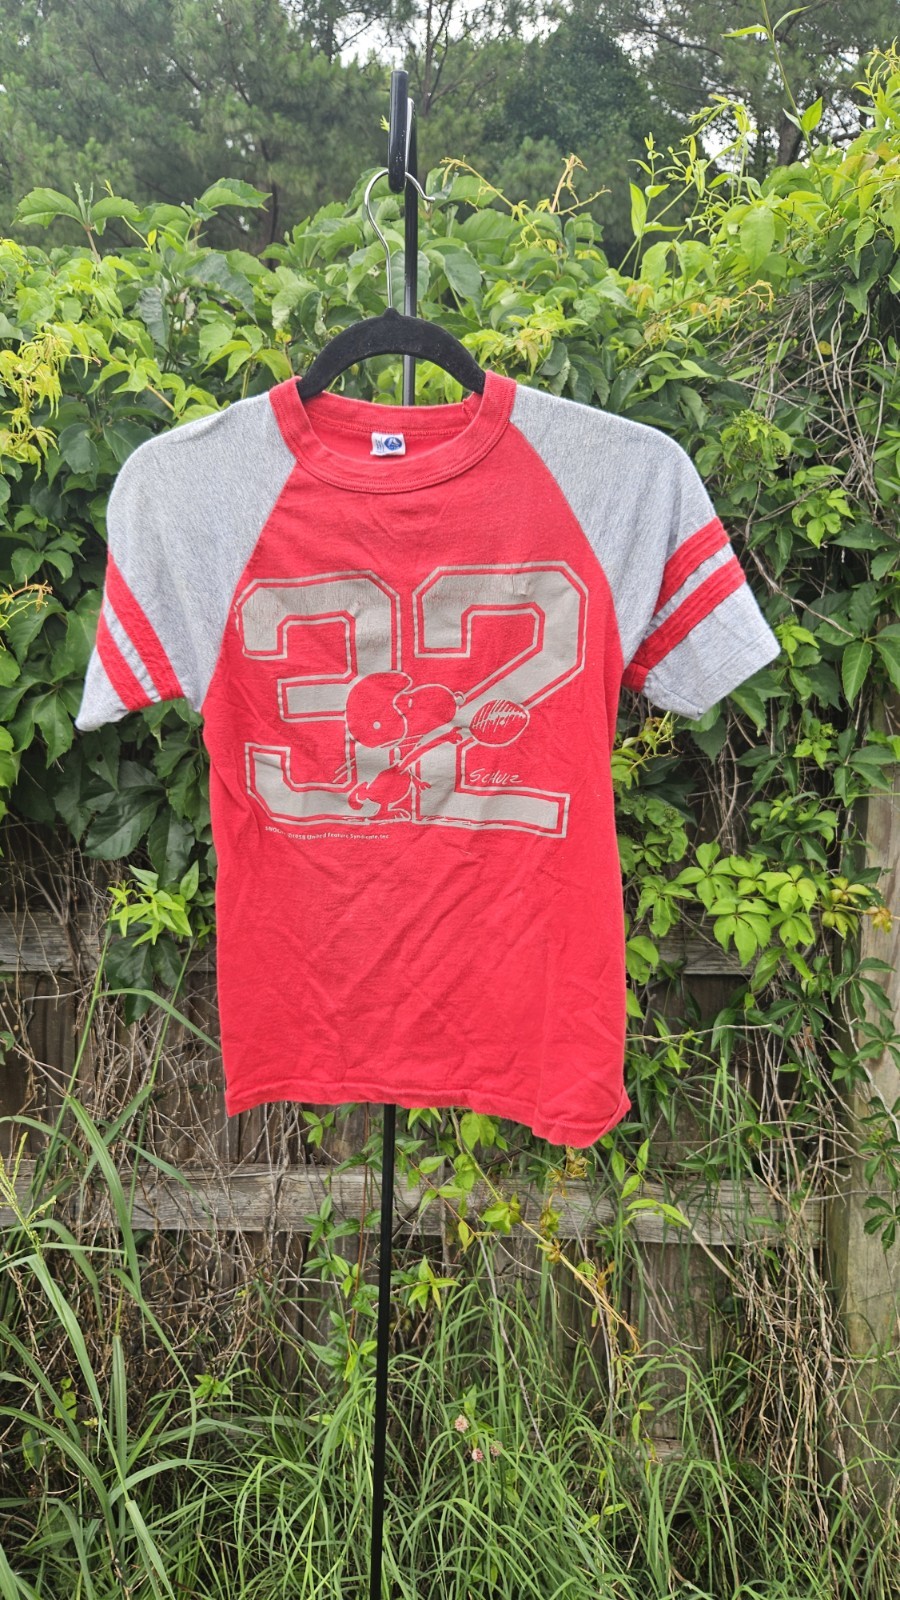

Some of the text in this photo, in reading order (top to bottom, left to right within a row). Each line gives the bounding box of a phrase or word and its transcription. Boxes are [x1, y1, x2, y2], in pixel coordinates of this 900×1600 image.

[234, 561, 590, 839] 32
[469, 767, 523, 785] SCHULZ
[306, 832, 327, 840] United
